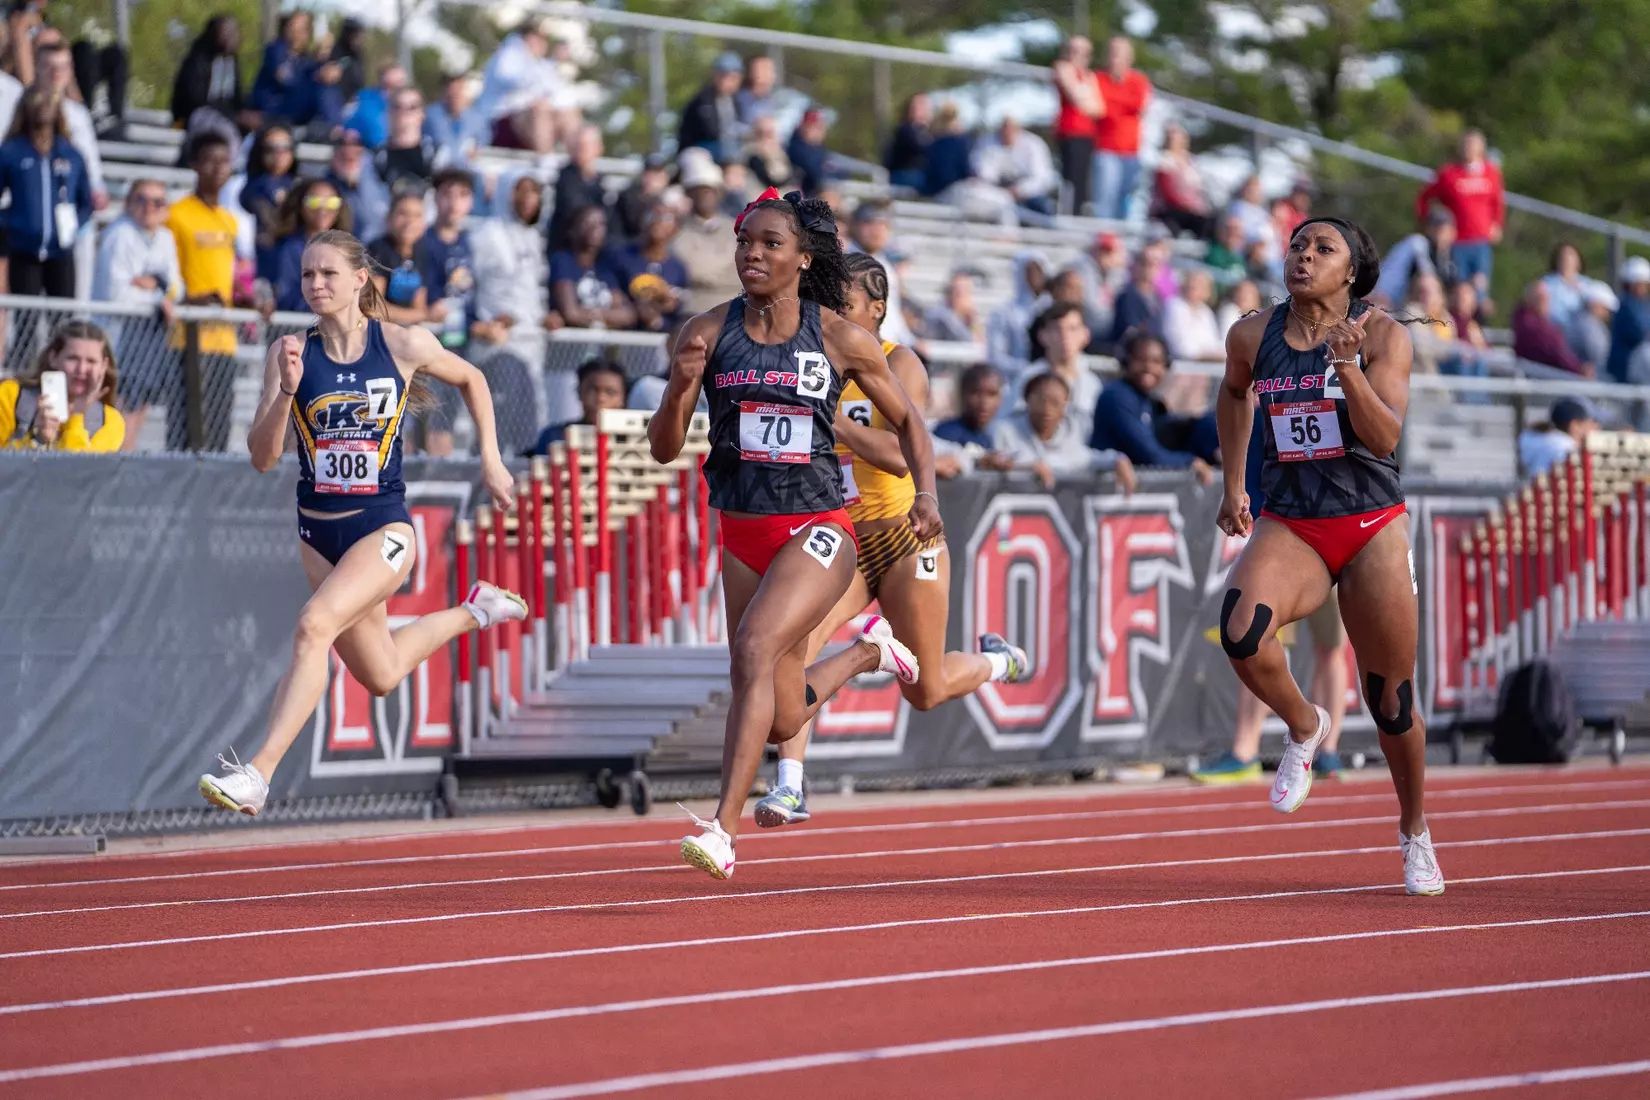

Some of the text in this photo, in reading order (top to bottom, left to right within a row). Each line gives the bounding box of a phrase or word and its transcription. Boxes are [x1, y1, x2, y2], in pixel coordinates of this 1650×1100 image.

[715, 369, 761, 388] BALL
[801, 359, 826, 392] 5
[1256, 376, 1297, 394] BALL
[371, 386, 393, 415] 7
[316, 430, 373, 440] KENT STATE
[760, 415, 792, 446] 70
[1290, 415, 1322, 445] 56
[325, 452, 368, 480] 308
[386, 536, 405, 562] 7
[809, 530, 837, 558] 5
[962, 493, 1197, 750] OF
